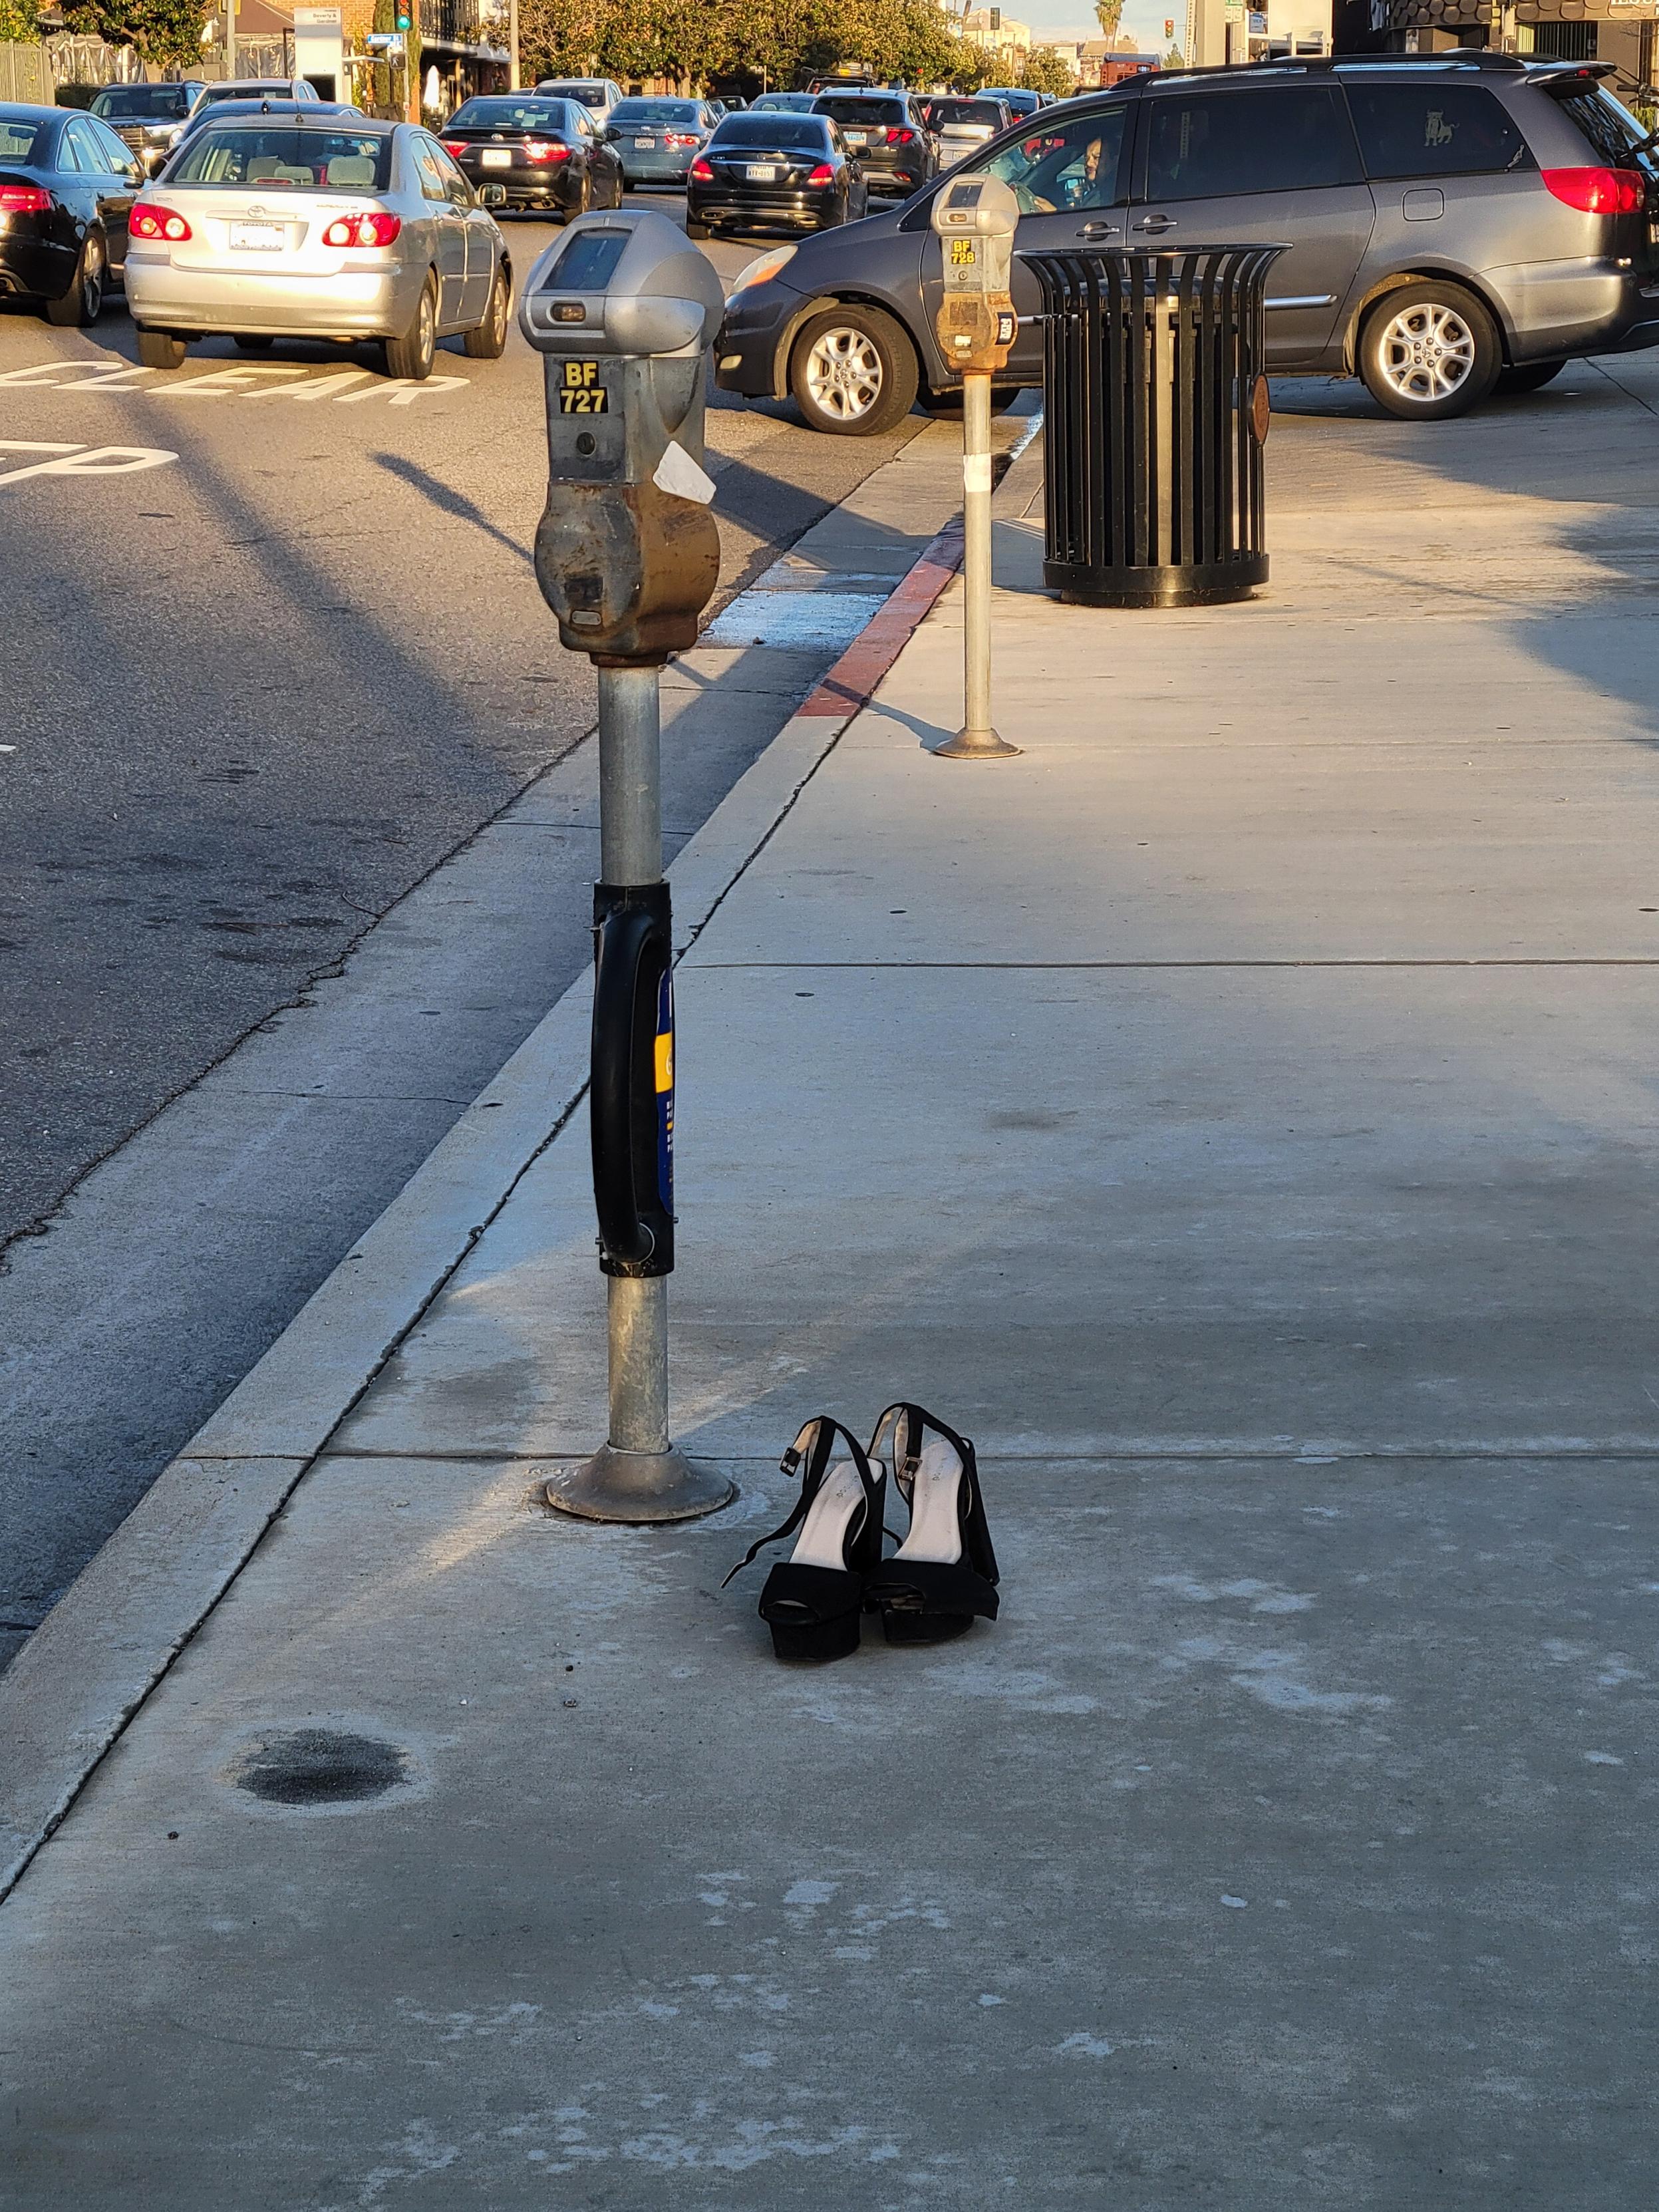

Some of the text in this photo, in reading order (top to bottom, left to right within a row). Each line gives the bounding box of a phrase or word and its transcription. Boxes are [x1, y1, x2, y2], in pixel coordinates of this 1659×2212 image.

[953, 240, 970, 251] BF
[951, 252, 975, 264] 728
[0, 360, 471, 404] CLEAR
[565, 363, 597, 386] BF
[561, 390, 605, 412] 727
